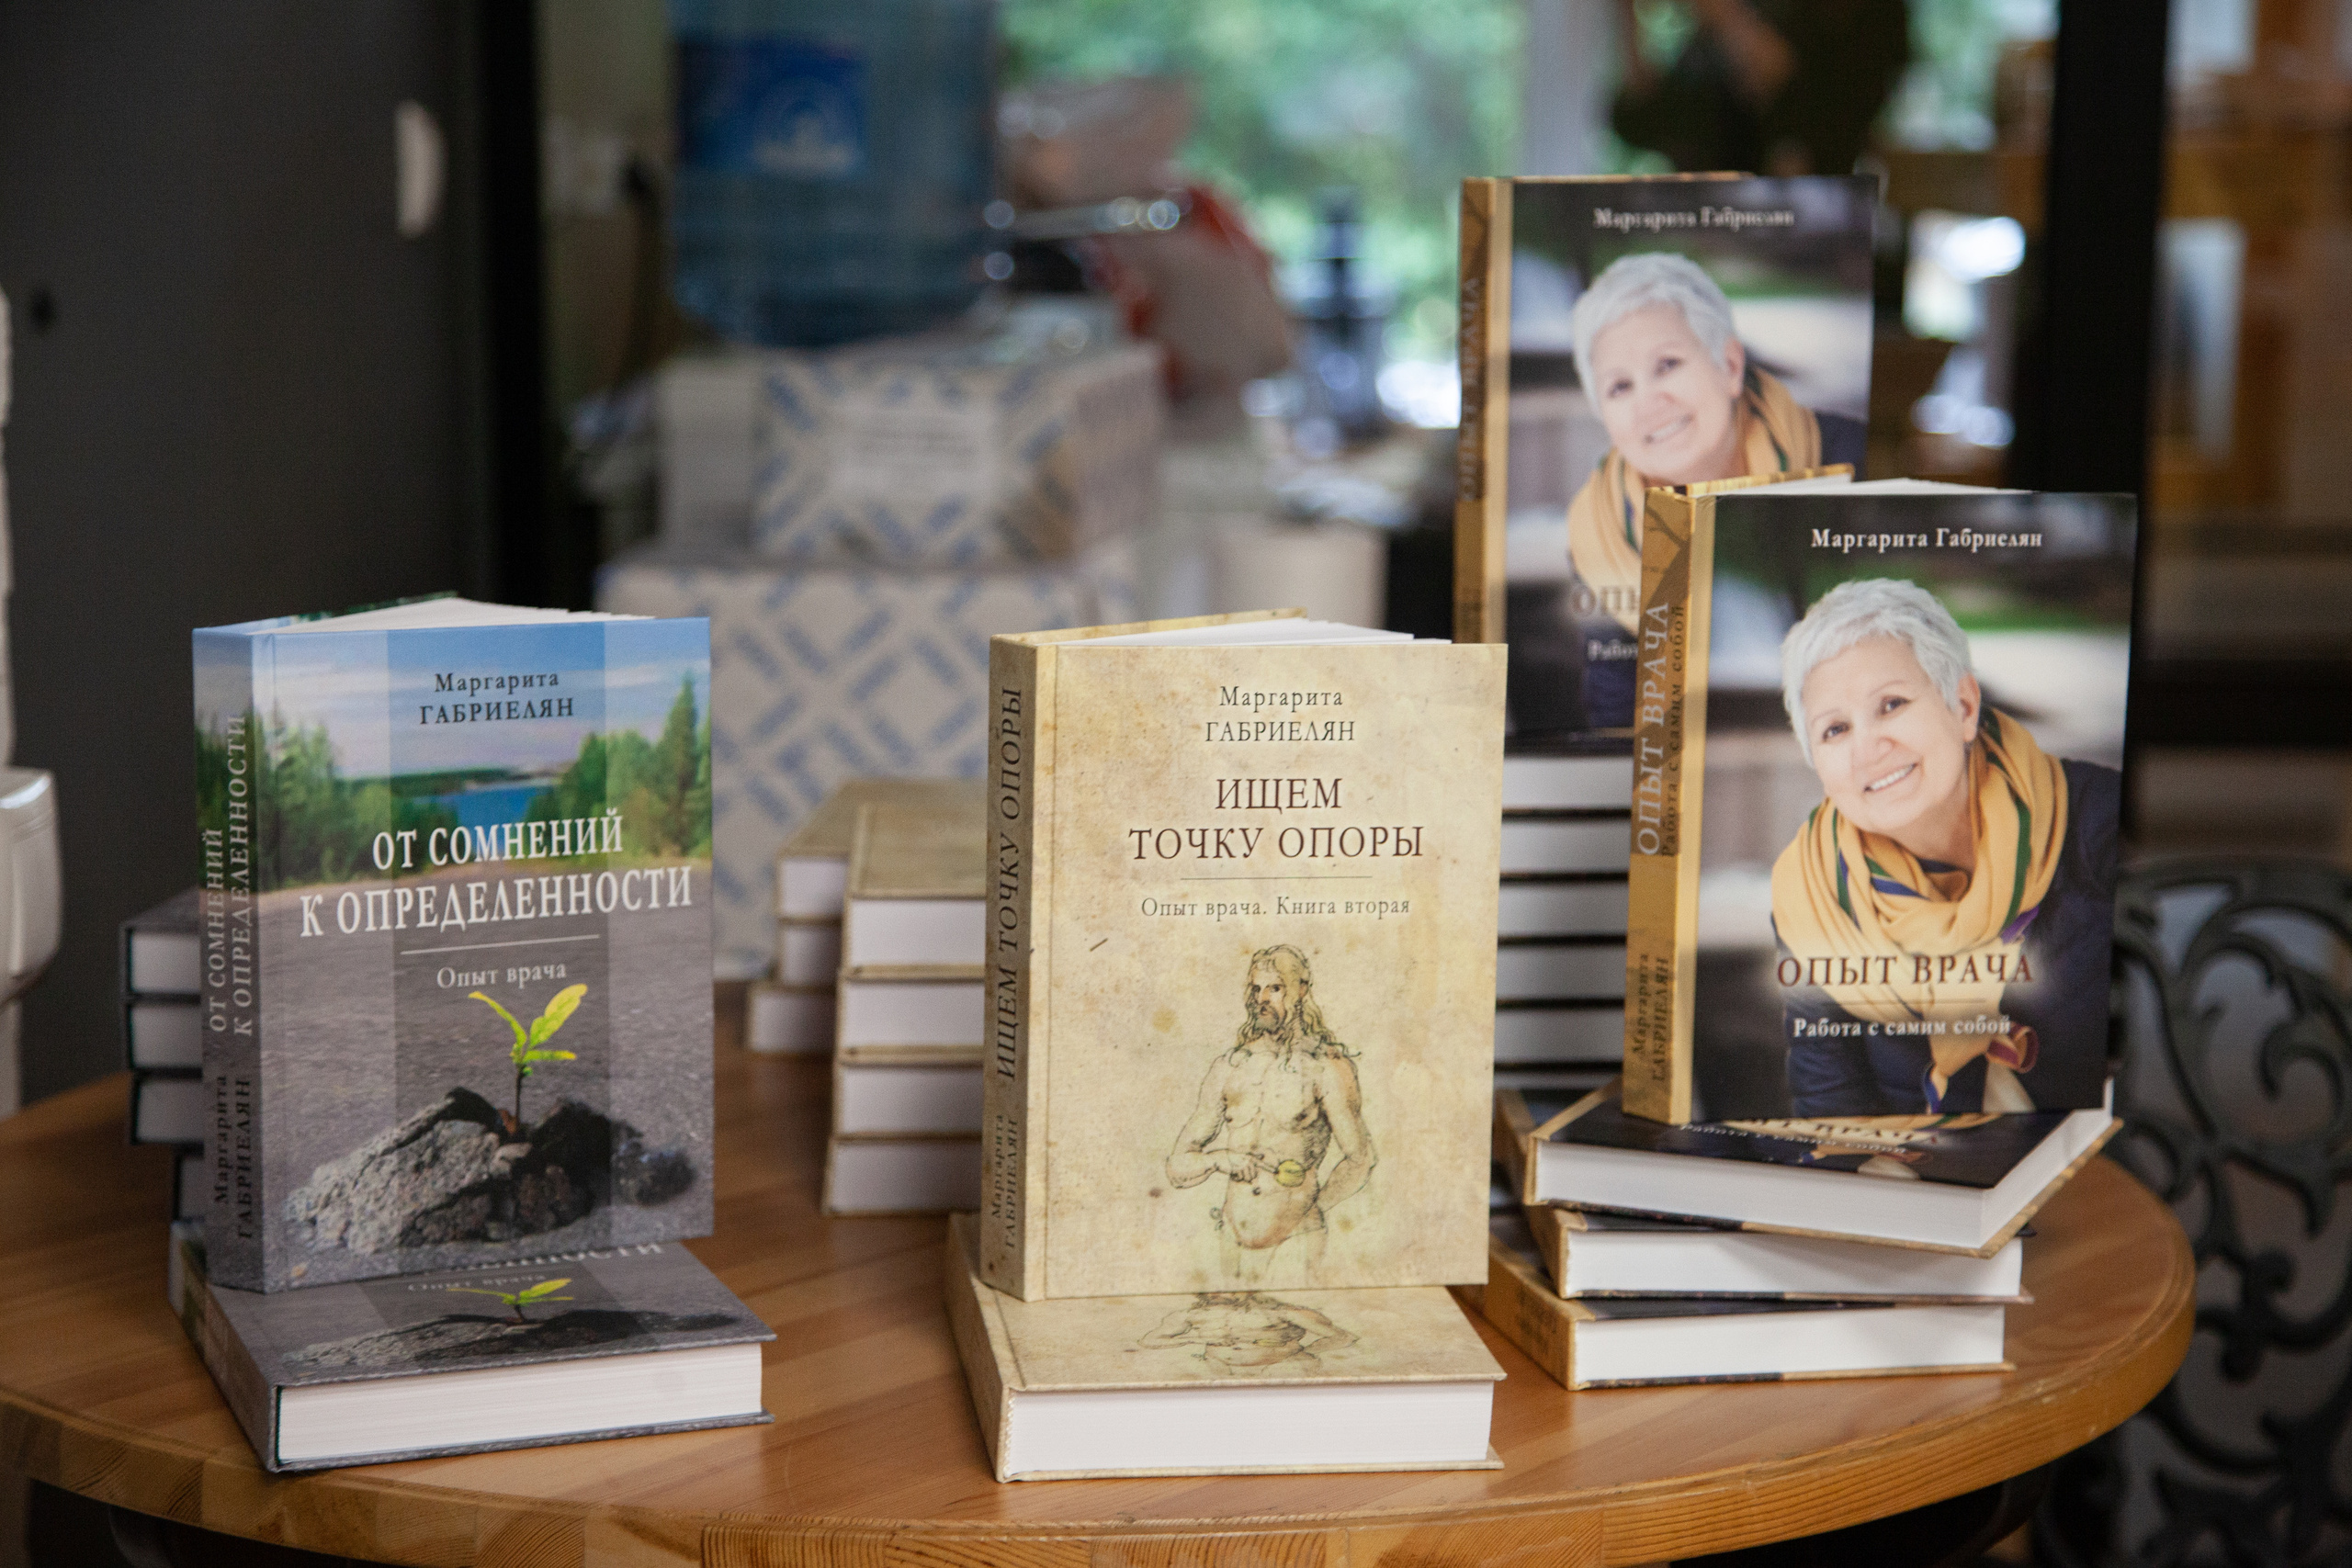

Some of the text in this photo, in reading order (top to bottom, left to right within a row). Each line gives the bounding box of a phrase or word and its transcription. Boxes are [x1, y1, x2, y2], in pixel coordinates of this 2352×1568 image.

[1811, 527, 2043, 553] Маргарита Габриелян
[435, 671, 560, 697] Маргарита
[1219, 686, 1344, 713] Маргарита
[419, 697, 574, 725] ГАБРИЕЛЯН
[1637, 602, 1669, 855] ОПЫТ ВРАЧА
[1204, 721, 1356, 743] ГАБРИЕЛЯН
[1215, 777, 1343, 814] ИЩЕМ
[372, 807, 624, 870] ОТ СОМНЕНИЙ
[1128, 826, 1424, 861] ТОЧКУ ОПОРЫ
[227, 715, 253, 1037] К ОПРЕДЕЛЕННОСТИ
[998, 688, 1022, 1080] ИЩЕМ ТОЧКУ ОПОРЫ
[300, 865, 694, 938] К ОПРЕДЕЛЕННОСТИ
[1141, 897, 1410, 921] Опыт врача. Книга вторая
[201, 828, 228, 1033] ОТ СОМНЕНИЙ
[435, 960, 567, 989] Опыт врача
[1777, 953, 2033, 987] ОПЫТ ВРАЧА
[1792, 1014, 2011, 1038] Работа с самим собой
[214, 1075, 231, 1206] Маргарита
[236, 1080, 253, 1239] ГАБРИЕЛЯН
[991, 1114, 1005, 1218] Маргарита
